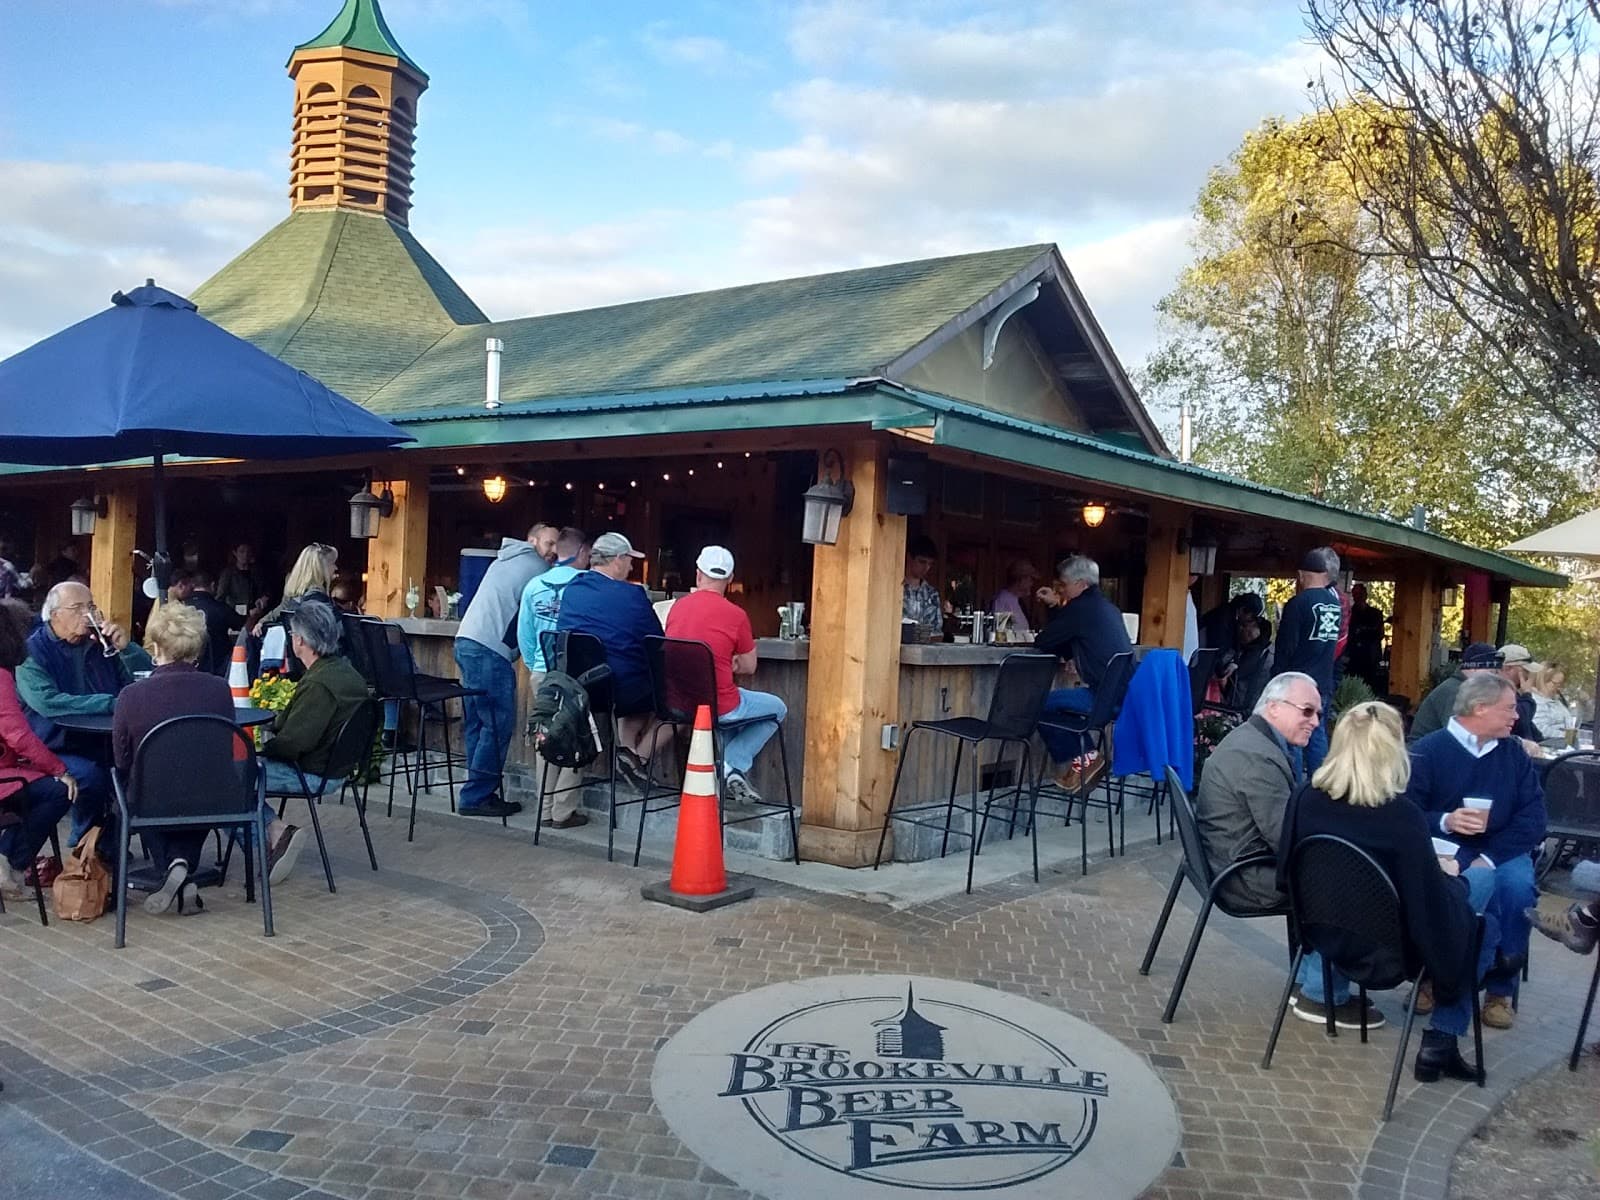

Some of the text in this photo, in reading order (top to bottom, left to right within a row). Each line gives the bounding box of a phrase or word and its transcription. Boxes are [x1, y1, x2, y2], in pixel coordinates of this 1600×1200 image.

[717, 1053, 1109, 1097] BROOKEVILLE
[766, 1042, 851, 1064] THE
[778, 1085, 964, 1132] BEER
[845, 1117, 1072, 1171] FARM
